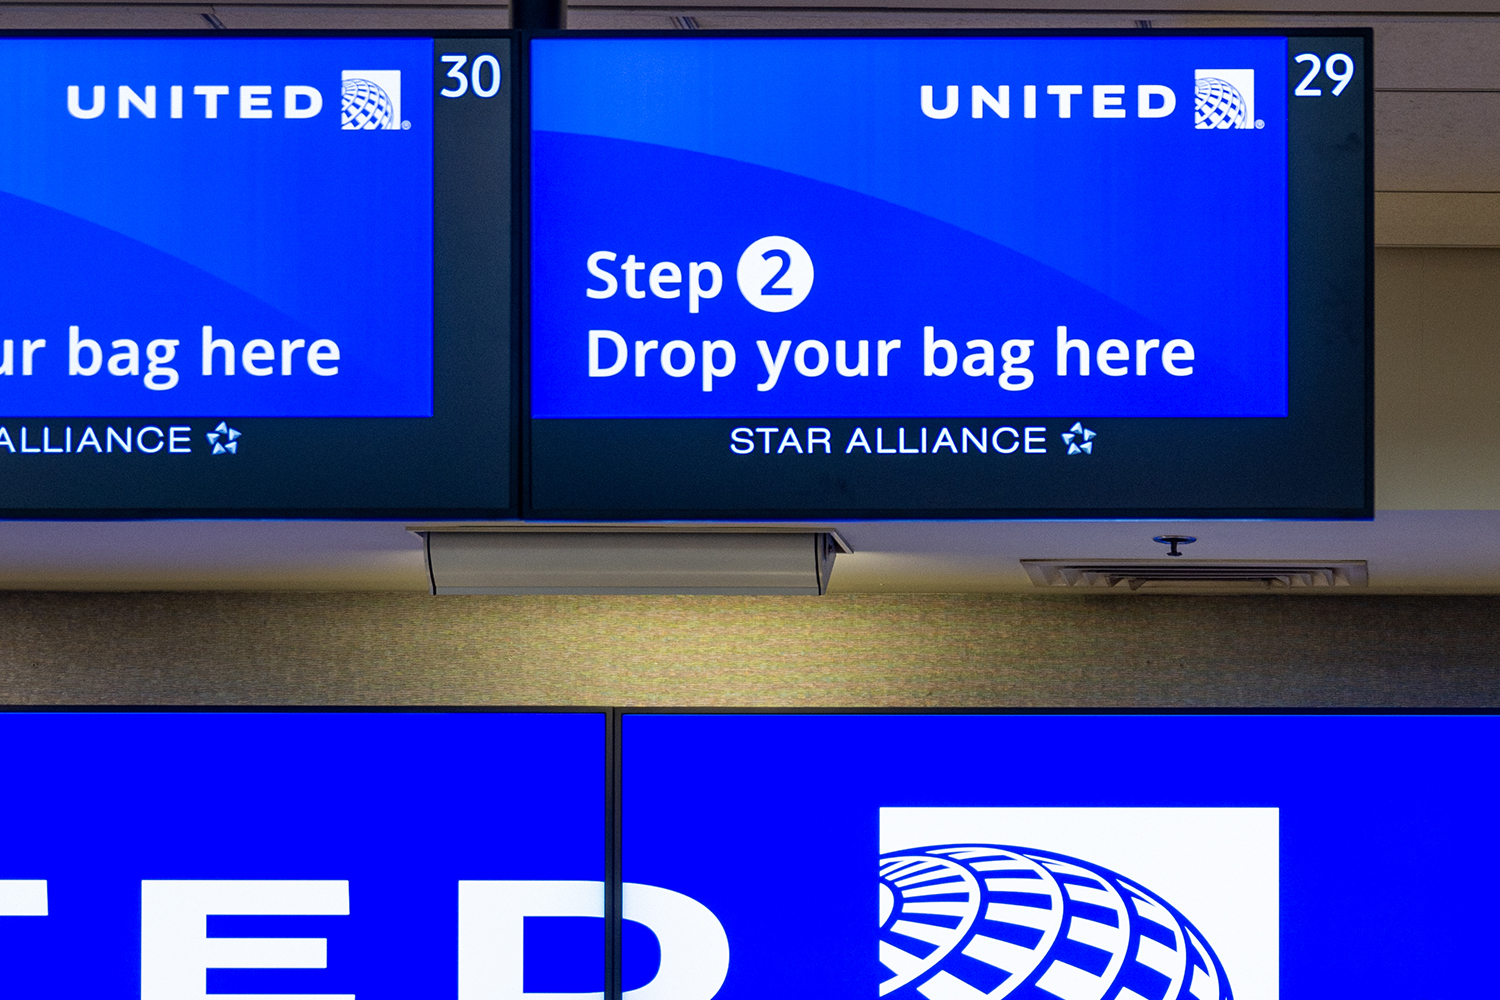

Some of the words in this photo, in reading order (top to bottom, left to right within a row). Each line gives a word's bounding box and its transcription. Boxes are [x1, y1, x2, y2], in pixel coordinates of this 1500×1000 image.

[441, 55, 500, 97] 30
[1295, 54, 1353, 96] 29
[67, 86, 322, 119] UNITED
[921, 85, 1176, 119] UNITED
[585, 250, 724, 314] Step
[759, 249, 793, 296] 2
[69, 326, 179, 390] bag
[202, 326, 340, 376] here
[589, 330, 736, 391] Drop
[756, 340, 901, 391] your
[924, 326, 1034, 391] bag
[1057, 326, 1194, 376] here
[0, 427, 191, 452] ALLIANCE
[731, 428, 830, 453] STAR
[846, 428, 1046, 453] ALLIANCE
